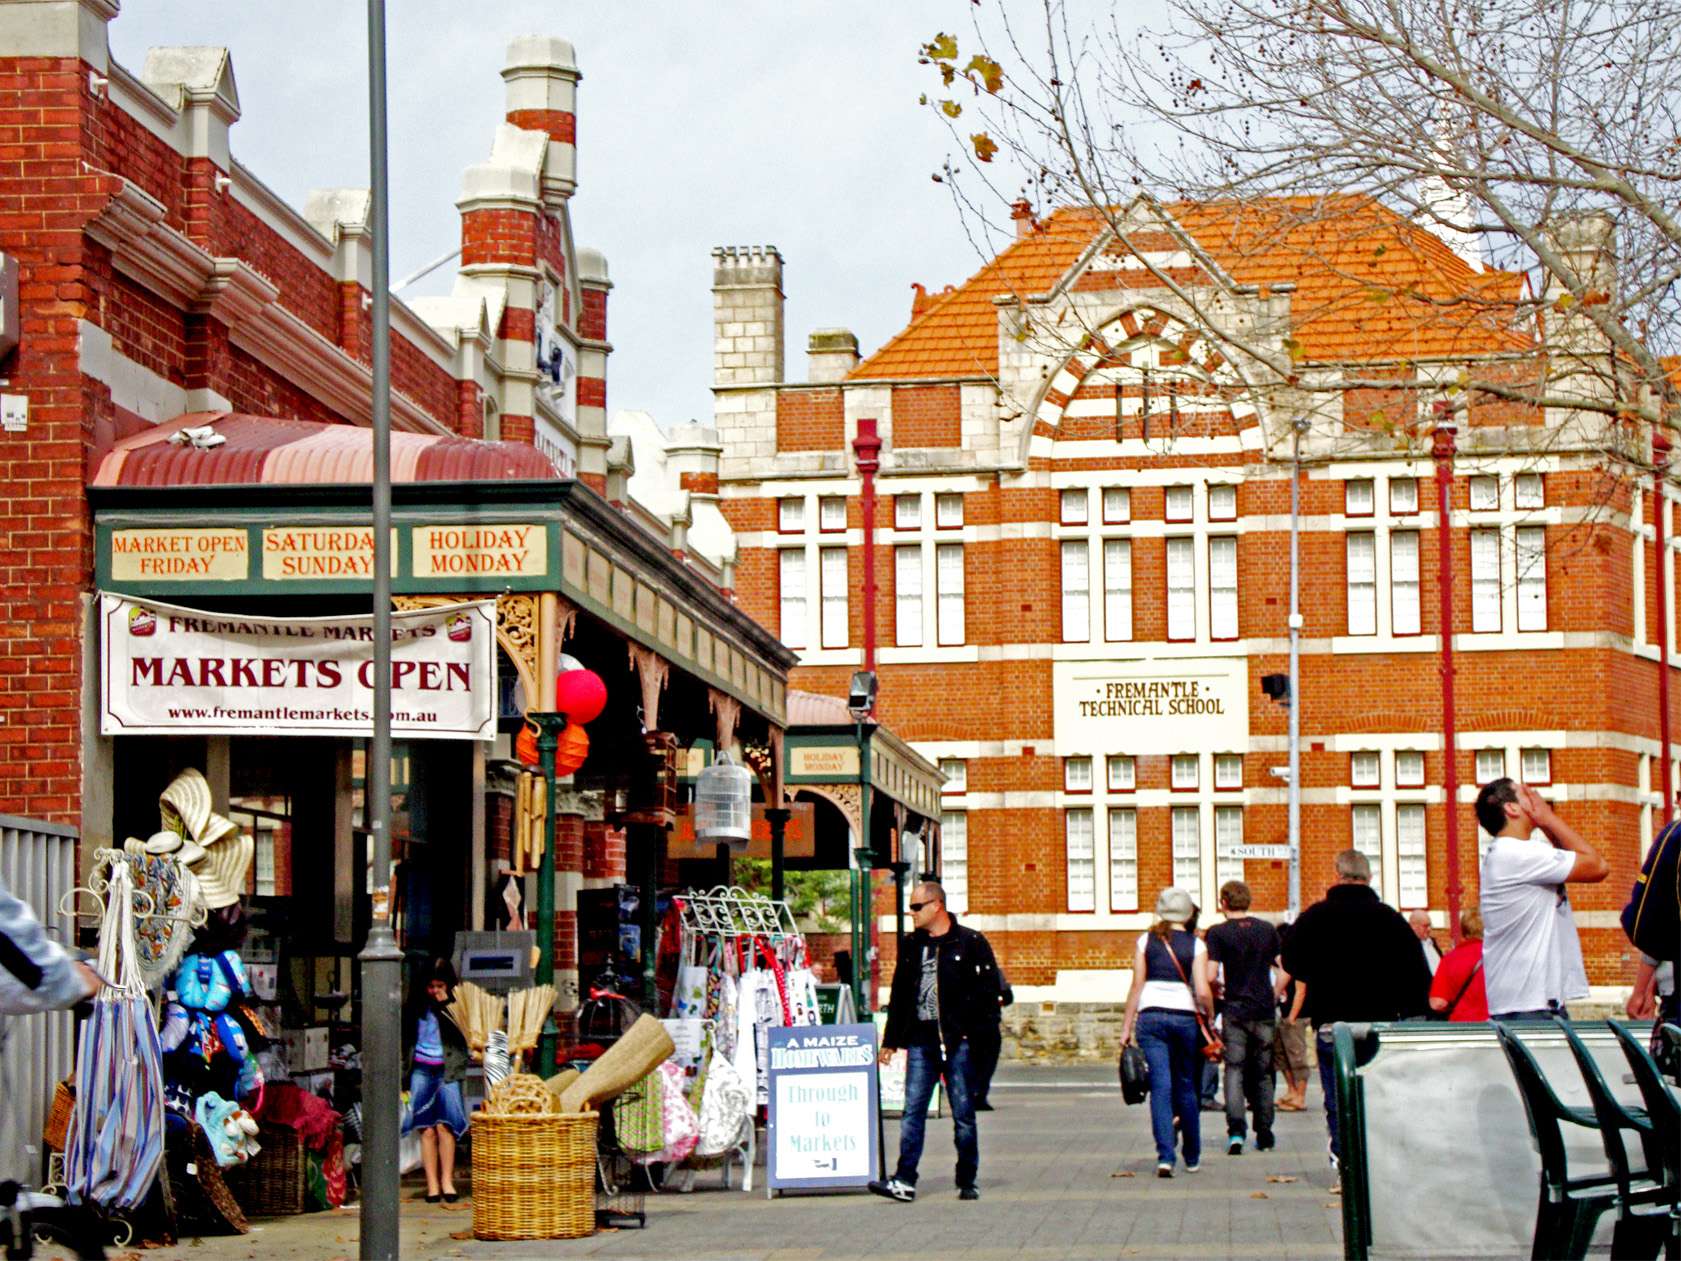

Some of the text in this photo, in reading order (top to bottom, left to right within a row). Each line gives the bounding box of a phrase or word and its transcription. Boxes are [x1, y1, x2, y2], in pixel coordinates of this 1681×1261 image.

[113, 536, 245, 552] MARKET OPEN
[265, 532, 375, 551] SATURDA
[429, 526, 530, 549] HOLIDAY
[140, 554, 214, 574] FRIDAY
[282, 554, 375, 575] SUNDAY
[431, 550, 528, 572] MONDAY
[168, 616, 437, 641] FREMANTLE MARETS
[131, 657, 471, 692] MARKETS OPEN
[1106, 681, 1199, 699] FREMANTLE
[168, 705, 437, 722] www.fremantlemarkets.m.au
[1079, 698, 1225, 717] TECHNICAL SCHOOL
[786, 1035, 859, 1049] A MAIZE
[787, 1083, 859, 1104] Through
[789, 1133, 857, 1153] Markets
